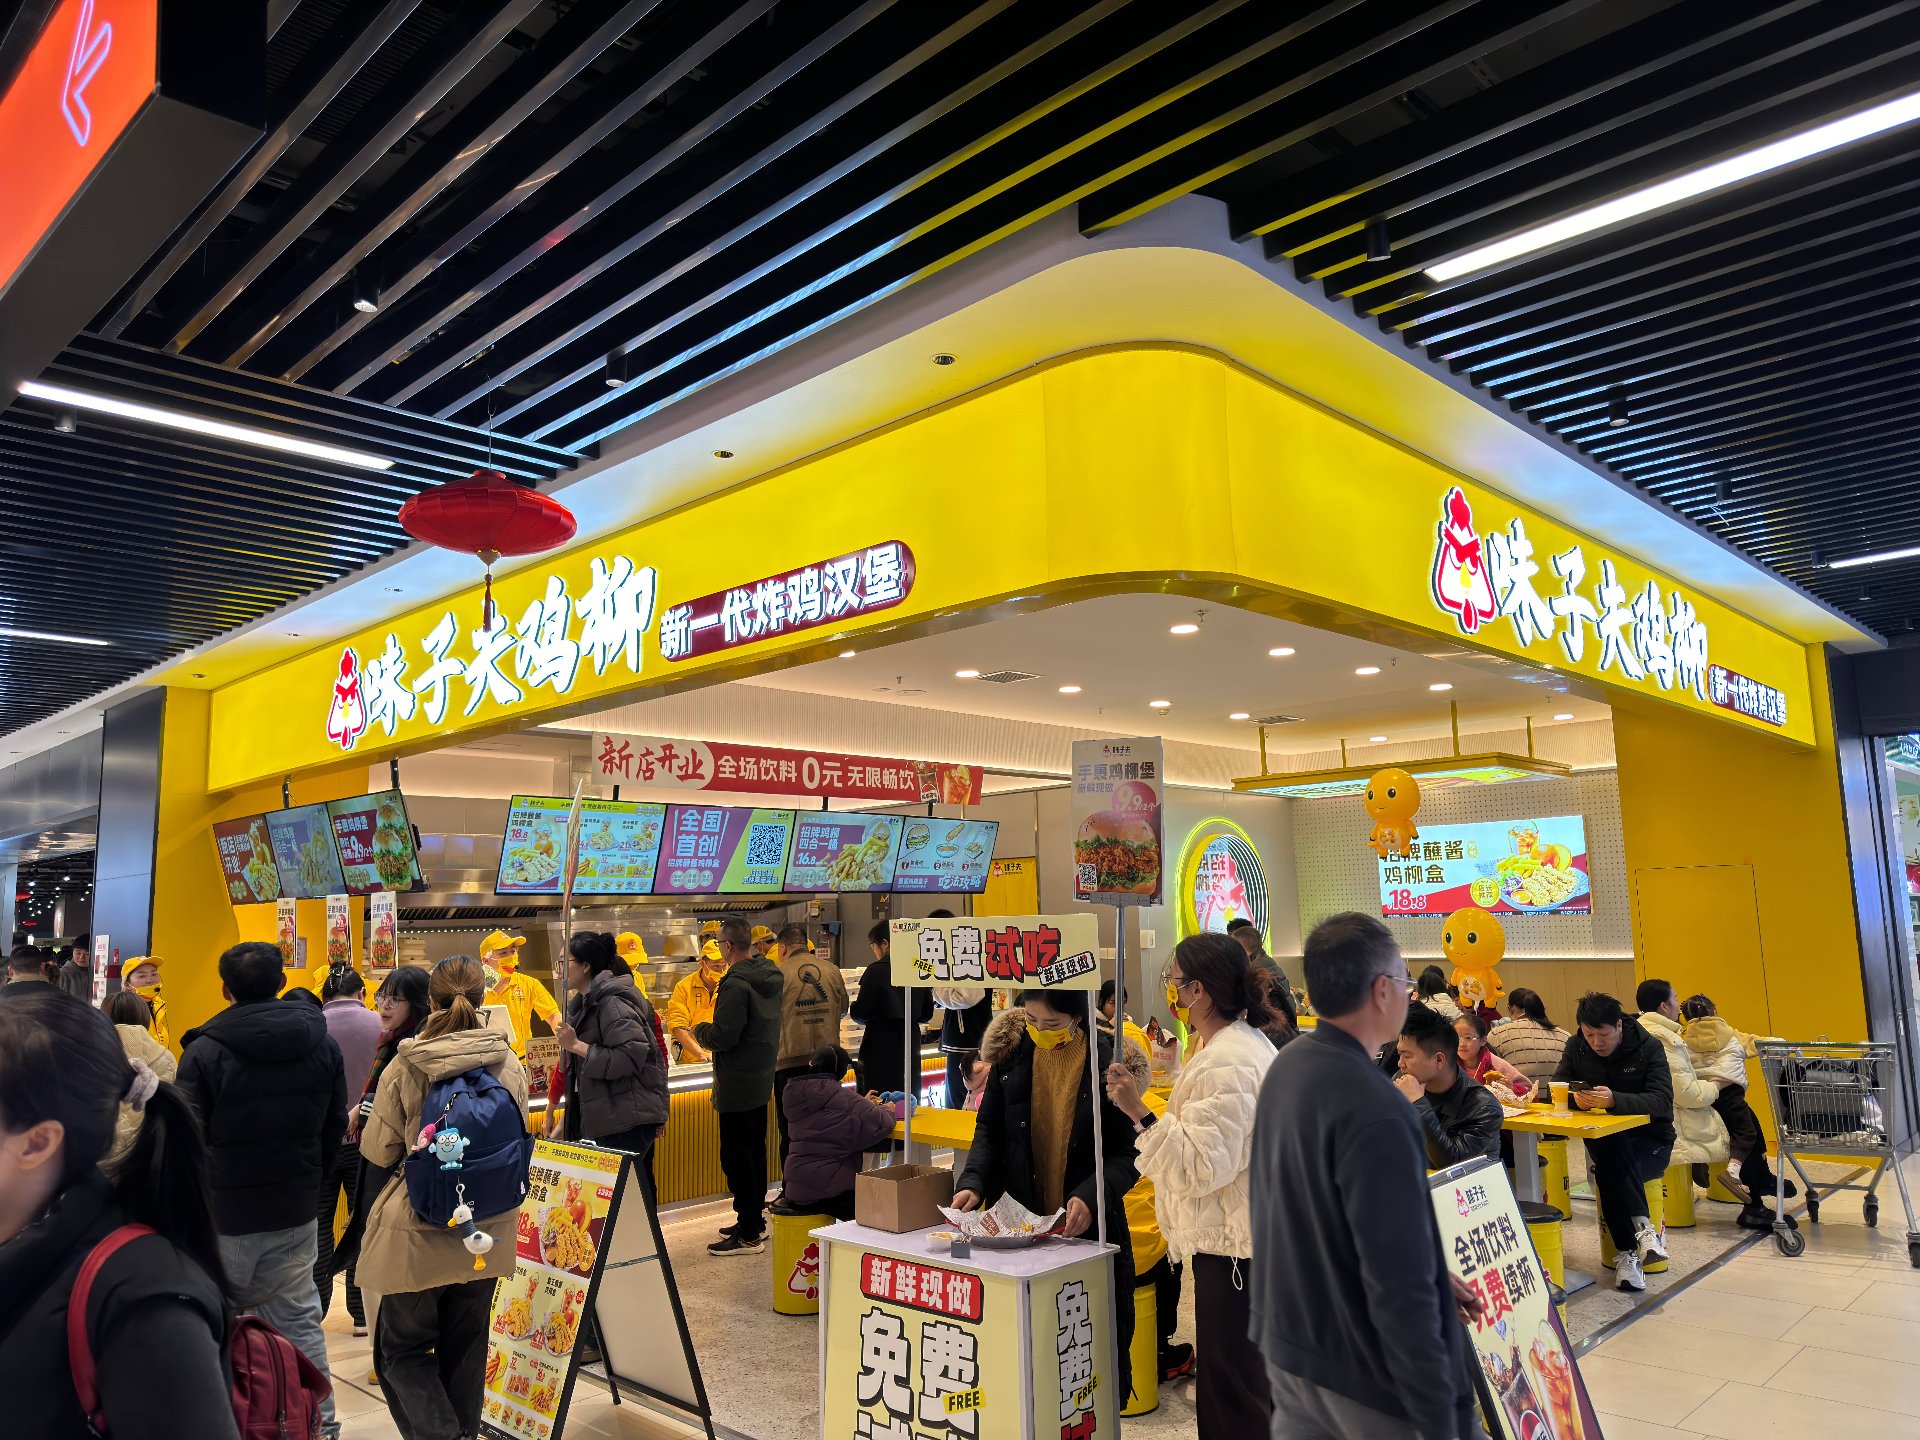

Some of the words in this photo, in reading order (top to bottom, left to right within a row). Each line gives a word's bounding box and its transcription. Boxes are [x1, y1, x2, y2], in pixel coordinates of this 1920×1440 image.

[661, 545, 907, 658] 新一代炸鸡汉堡
[1709, 666, 1787, 725] 新一代炸鸡汉堡
[598, 736, 706, 783] 新店开业
[1078, 762, 1155, 781] 手裹鸡柳堡
[1078, 783, 1114, 793] 新鲜现做
[680, 810, 722, 832] 全国
[801, 826, 840, 838] 招牌鸡柳
[676, 834, 719, 857] 首创
[938, 873, 981, 889] 吃法攻略
[1384, 865, 1445, 884] 鸡柳盒
[918, 924, 1061, 982] 免费试吃
[914, 959, 933, 973] FREE
[1043, 953, 1094, 983] 新鲜现做
[1454, 1213, 1520, 1276] 全场饮料
[870, 1257, 972, 1316] 新鲜现做
[948, 1391, 981, 1411] FREE
[1077, 1376, 1098, 1403] FREE
